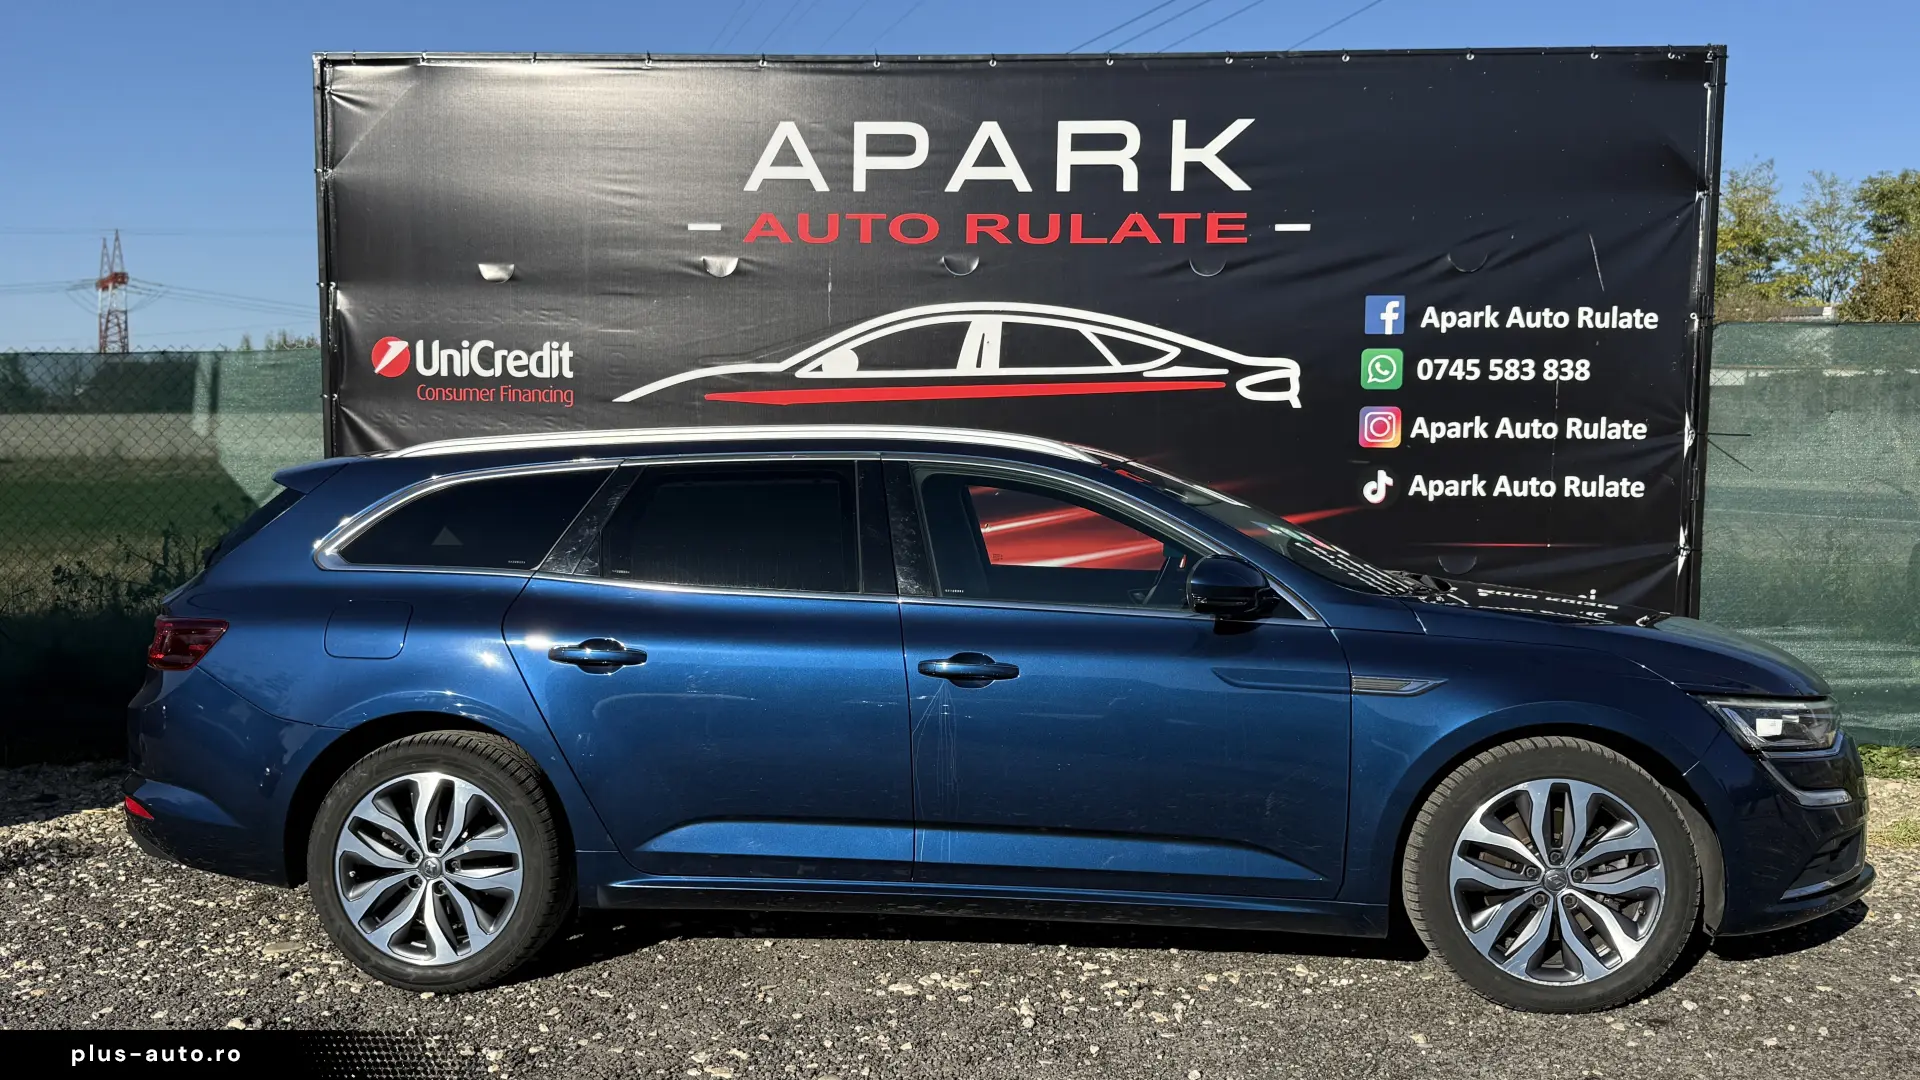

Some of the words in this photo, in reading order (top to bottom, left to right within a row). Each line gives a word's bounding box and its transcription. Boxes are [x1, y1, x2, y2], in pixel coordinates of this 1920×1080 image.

[743, 118, 1255, 193] APARK
[743, 212, 940, 245] AUTO
[965, 211, 1249, 245] RULATE
[1420, 305, 1499, 333] Apark
[1505, 306, 1569, 330] Auto
[1577, 305, 1659, 330] Rulate
[415, 338, 574, 379] UniCredit
[1416, 358, 1481, 381] 0745
[1488, 358, 1536, 381] 583
[1543, 358, 1591, 381] 838
[416, 384, 496, 403] Consumer
[499, 385, 574, 408] Financing
[1410, 416, 1489, 443] Apark
[1495, 417, 1558, 440] Auto
[1566, 417, 1648, 440] Rulate
[1408, 474, 1486, 502] Apark
[1493, 475, 1557, 498] Auto
[1564, 475, 1646, 498] Rulate
